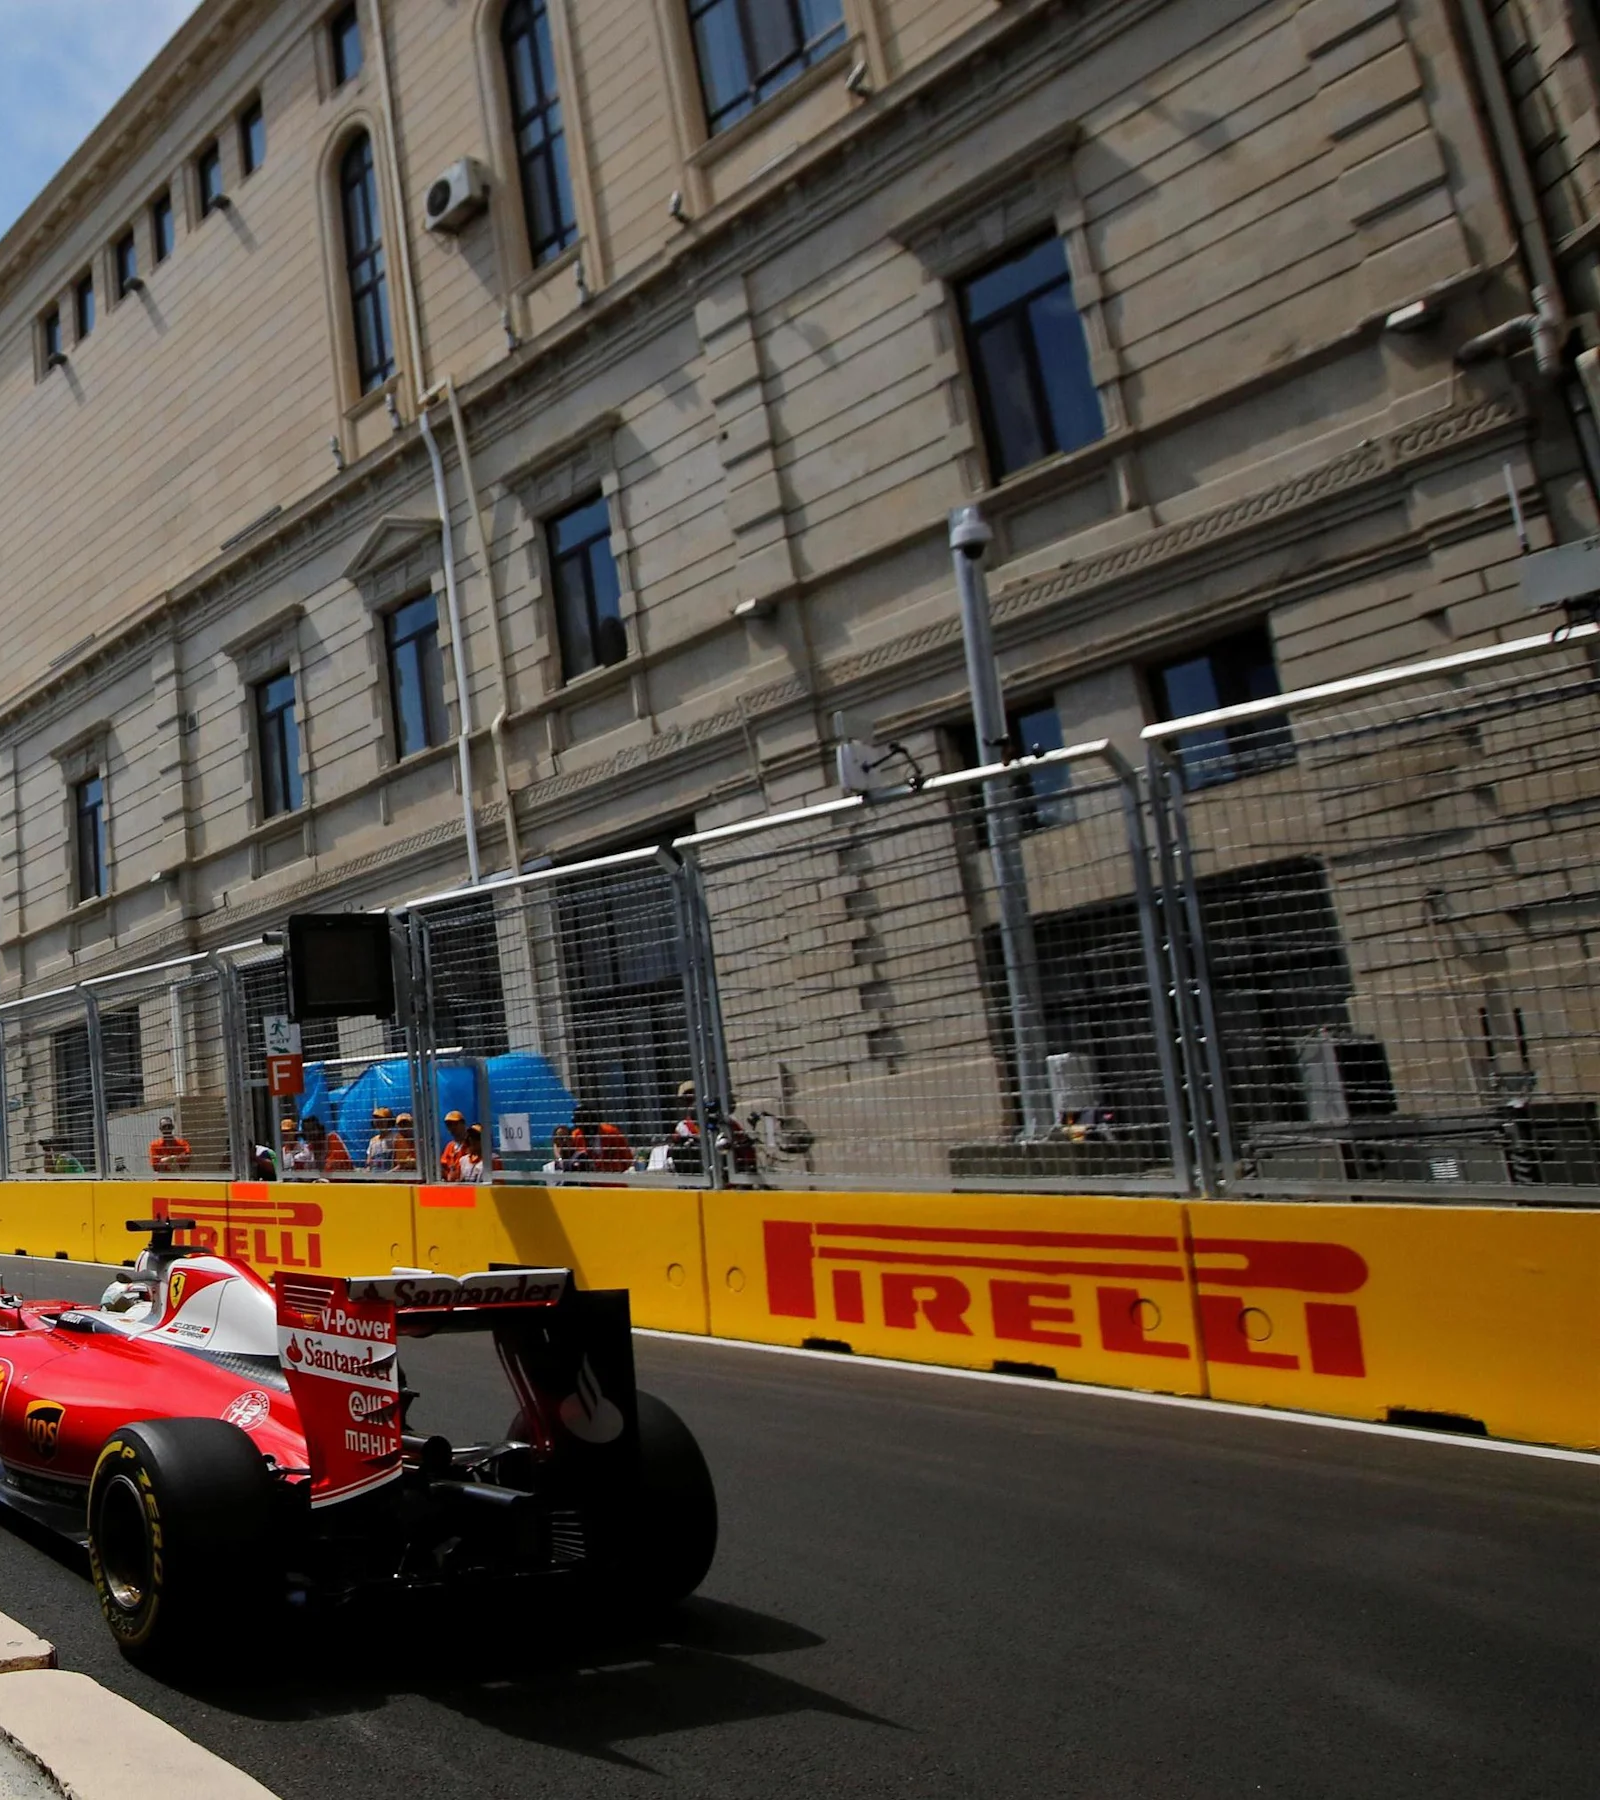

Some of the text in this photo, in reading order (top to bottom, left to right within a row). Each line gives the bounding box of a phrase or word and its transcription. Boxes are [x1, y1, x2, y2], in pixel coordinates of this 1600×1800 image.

[273, 1060, 292, 1091] F
[394, 1275, 559, 1306] Santander
[763, 1220, 1368, 1378] PIRELLI
[321, 1308, 391, 1340] V-Power
[305, 1337, 392, 1382] Santander
[136, 1467, 163, 1585] ZERO
